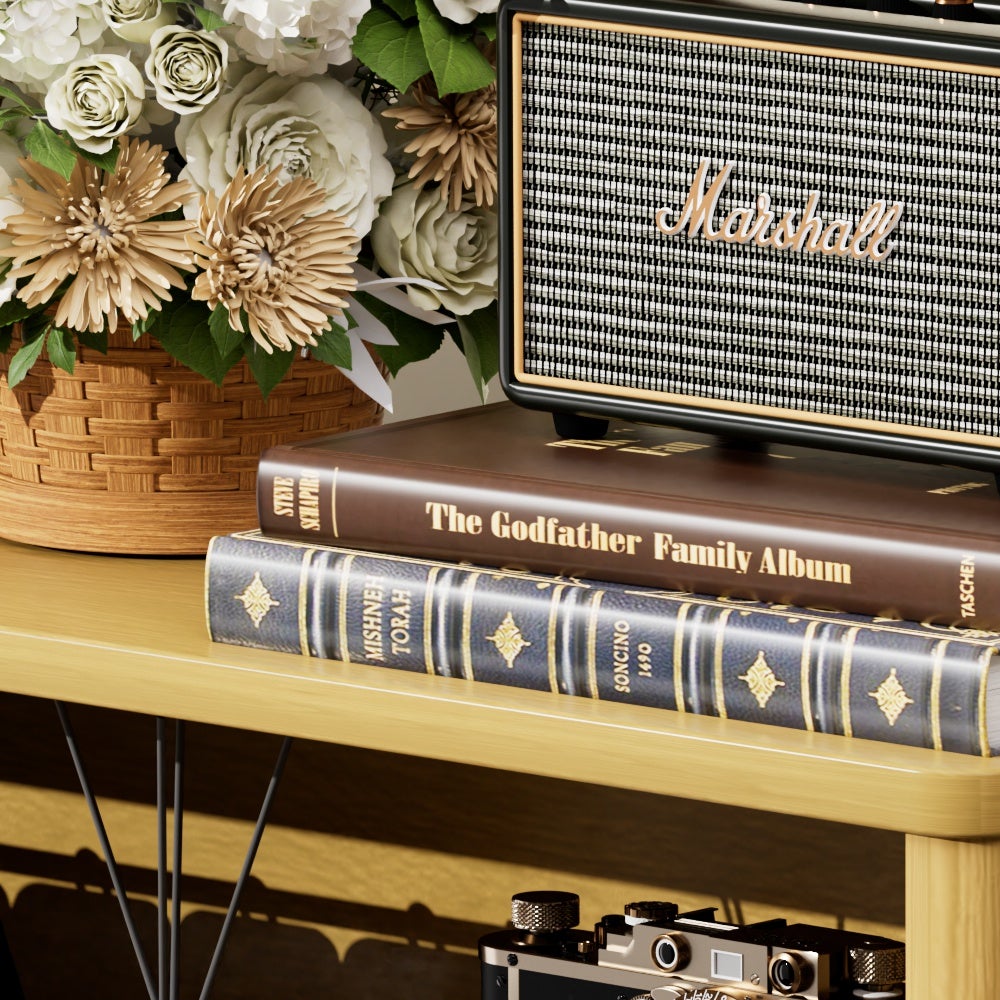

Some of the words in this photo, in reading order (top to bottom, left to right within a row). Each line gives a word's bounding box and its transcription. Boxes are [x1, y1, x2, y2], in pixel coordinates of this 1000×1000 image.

[655, 157, 904, 262] Marshall
[273, 475, 294, 517] STEVE
[425, 501, 483, 535] The
[491, 510, 643, 555] Godfather
[653, 532, 752, 574] Family
[759, 546, 852, 584] Album
[362, 574, 385, 662] MISHNEH
[959, 552, 976, 618] TASCHEN
[390, 588, 411, 655] TORAH
[613, 620, 630, 693] SONCINO
[637, 642, 652, 677] 1490
